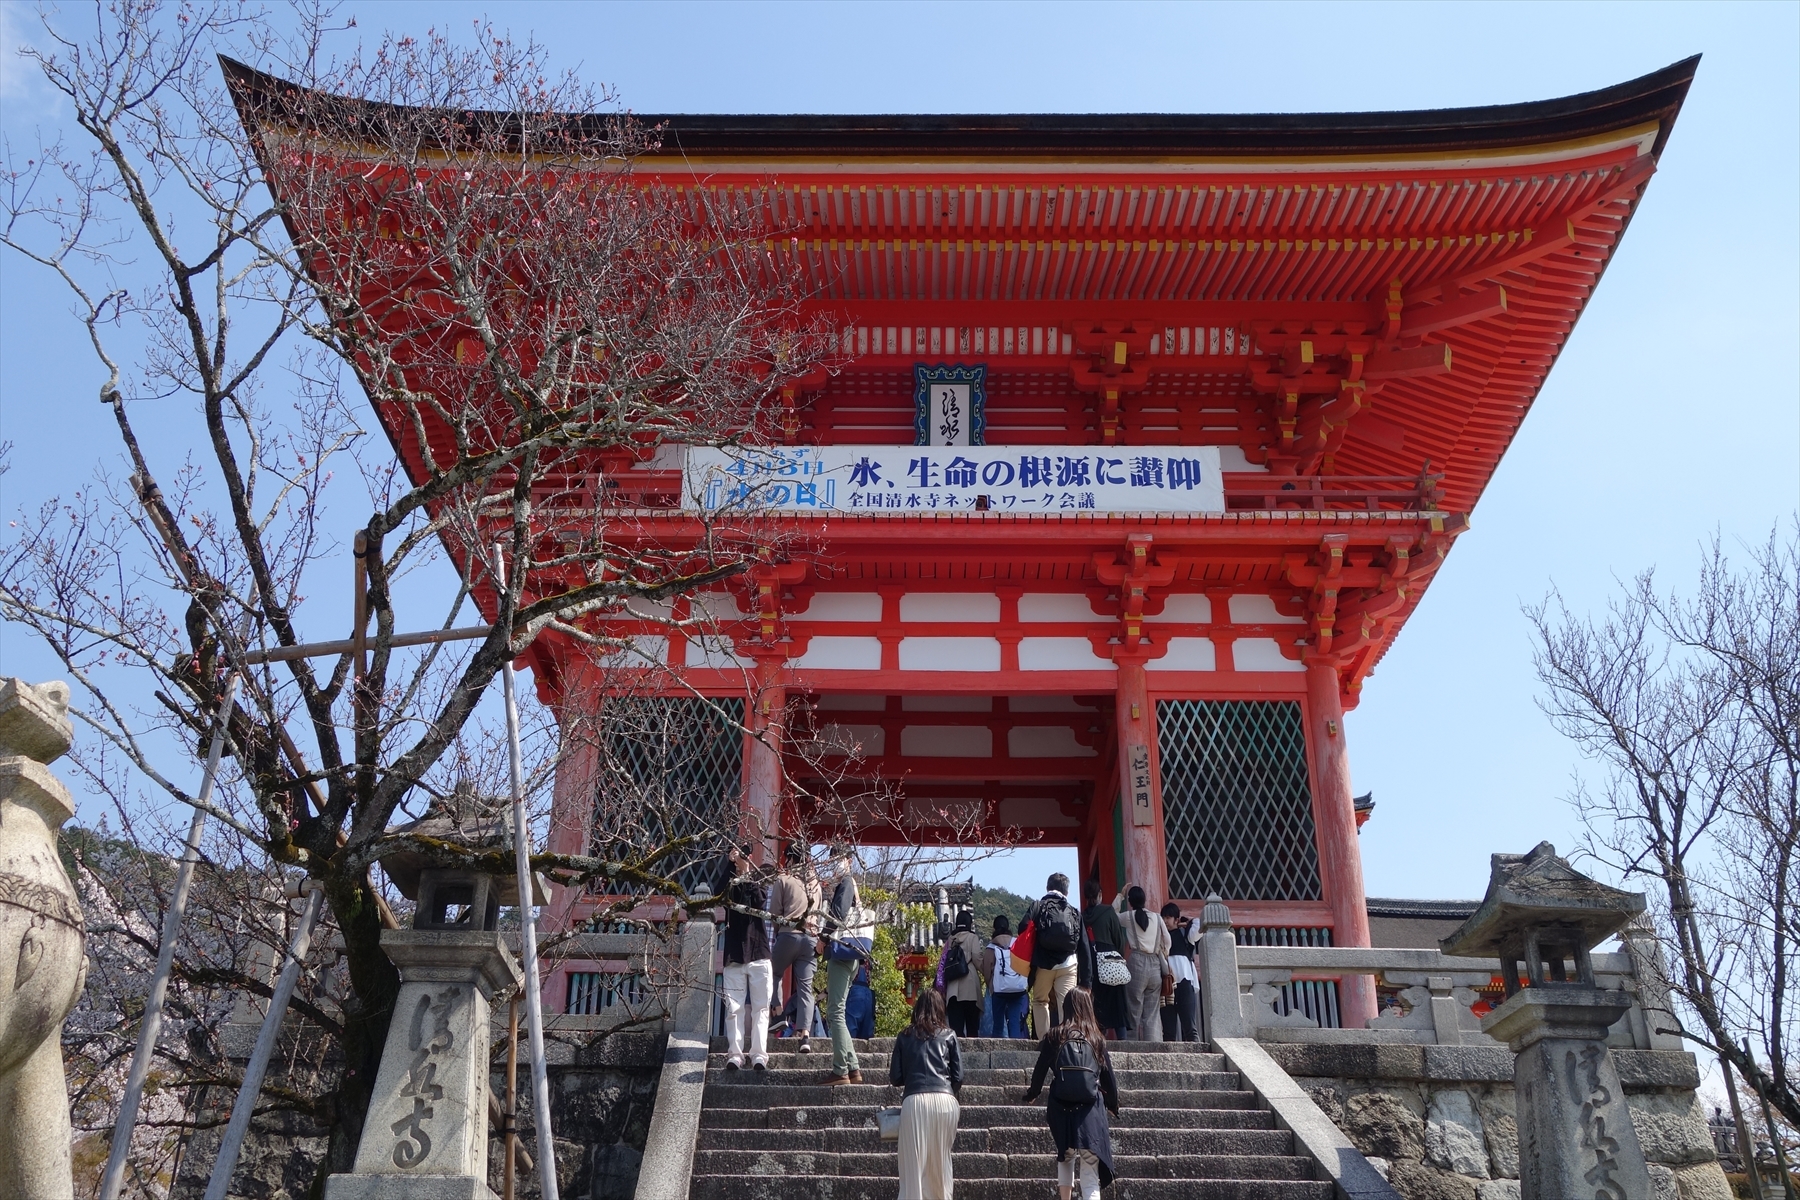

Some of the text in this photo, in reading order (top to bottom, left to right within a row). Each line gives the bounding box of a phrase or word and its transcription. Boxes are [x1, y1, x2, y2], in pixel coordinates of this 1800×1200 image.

[846, 456, 1202, 491] 水、生命の根源に讃仰
[846, 491, 1097, 509] 全国清水寺ネットワーク会議
[1132, 758, 1149, 808] 仁王門
